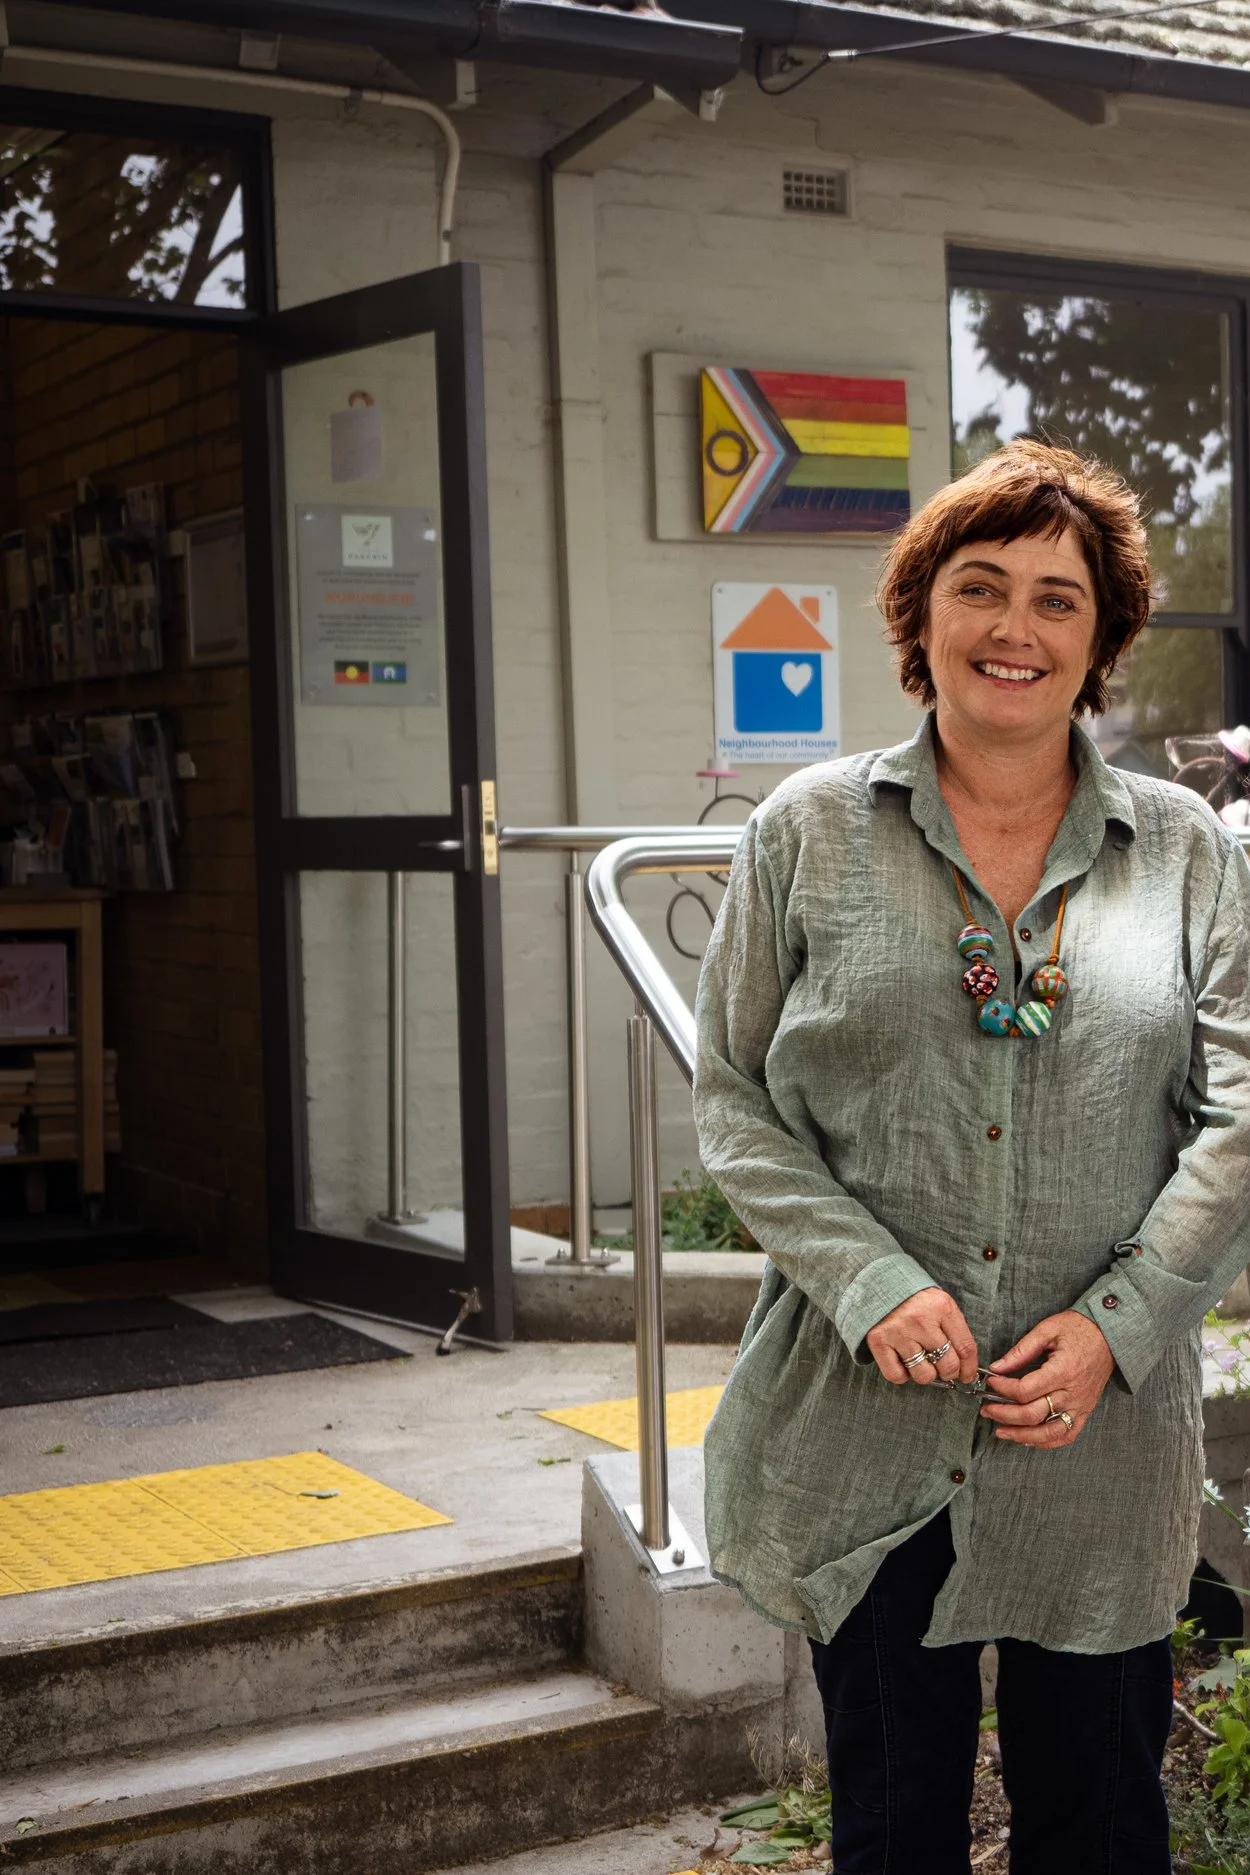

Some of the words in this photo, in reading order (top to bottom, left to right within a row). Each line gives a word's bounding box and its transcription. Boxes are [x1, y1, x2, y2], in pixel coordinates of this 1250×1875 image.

[719, 738, 798, 750] Neighbourhood
[801, 739, 838, 749] Houses
[730, 751, 743, 759] The
[745, 751, 765, 760] heart
[789, 752, 828, 761] community
